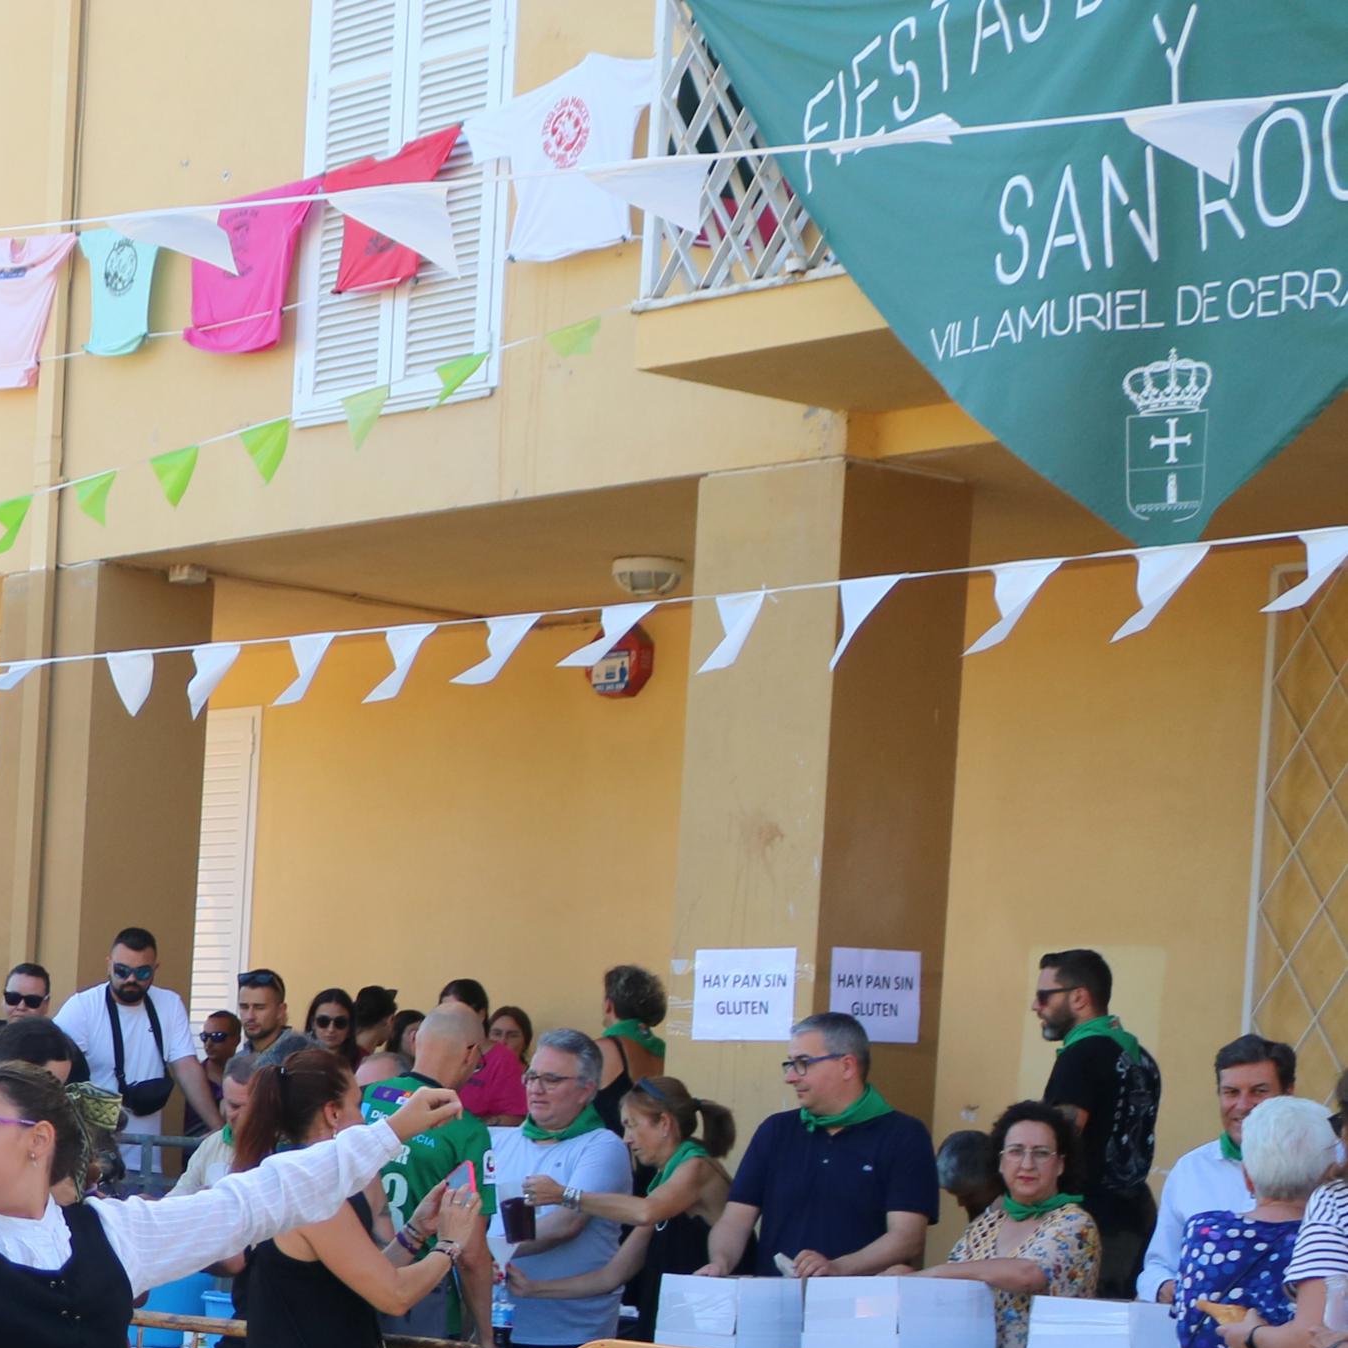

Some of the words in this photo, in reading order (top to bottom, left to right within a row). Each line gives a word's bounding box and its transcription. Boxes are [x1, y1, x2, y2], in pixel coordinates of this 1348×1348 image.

[1152, 3, 1197, 105] Y
[995, 145, 1160, 285] SAN
[930, 289, 1165, 361] VILLAMURIEL
[1177, 281, 1223, 327] DE
[703, 974, 729, 988] HAY
[733, 974, 763, 988] PAN
[764, 973, 787, 988] SIN
[837, 973, 864, 989] HAY
[865, 974, 891, 990] PAN
[894, 975, 914, 991] SIN
[716, 1000, 769, 1015] GLUTEN
[851, 1000, 899, 1017] GLUTEN
